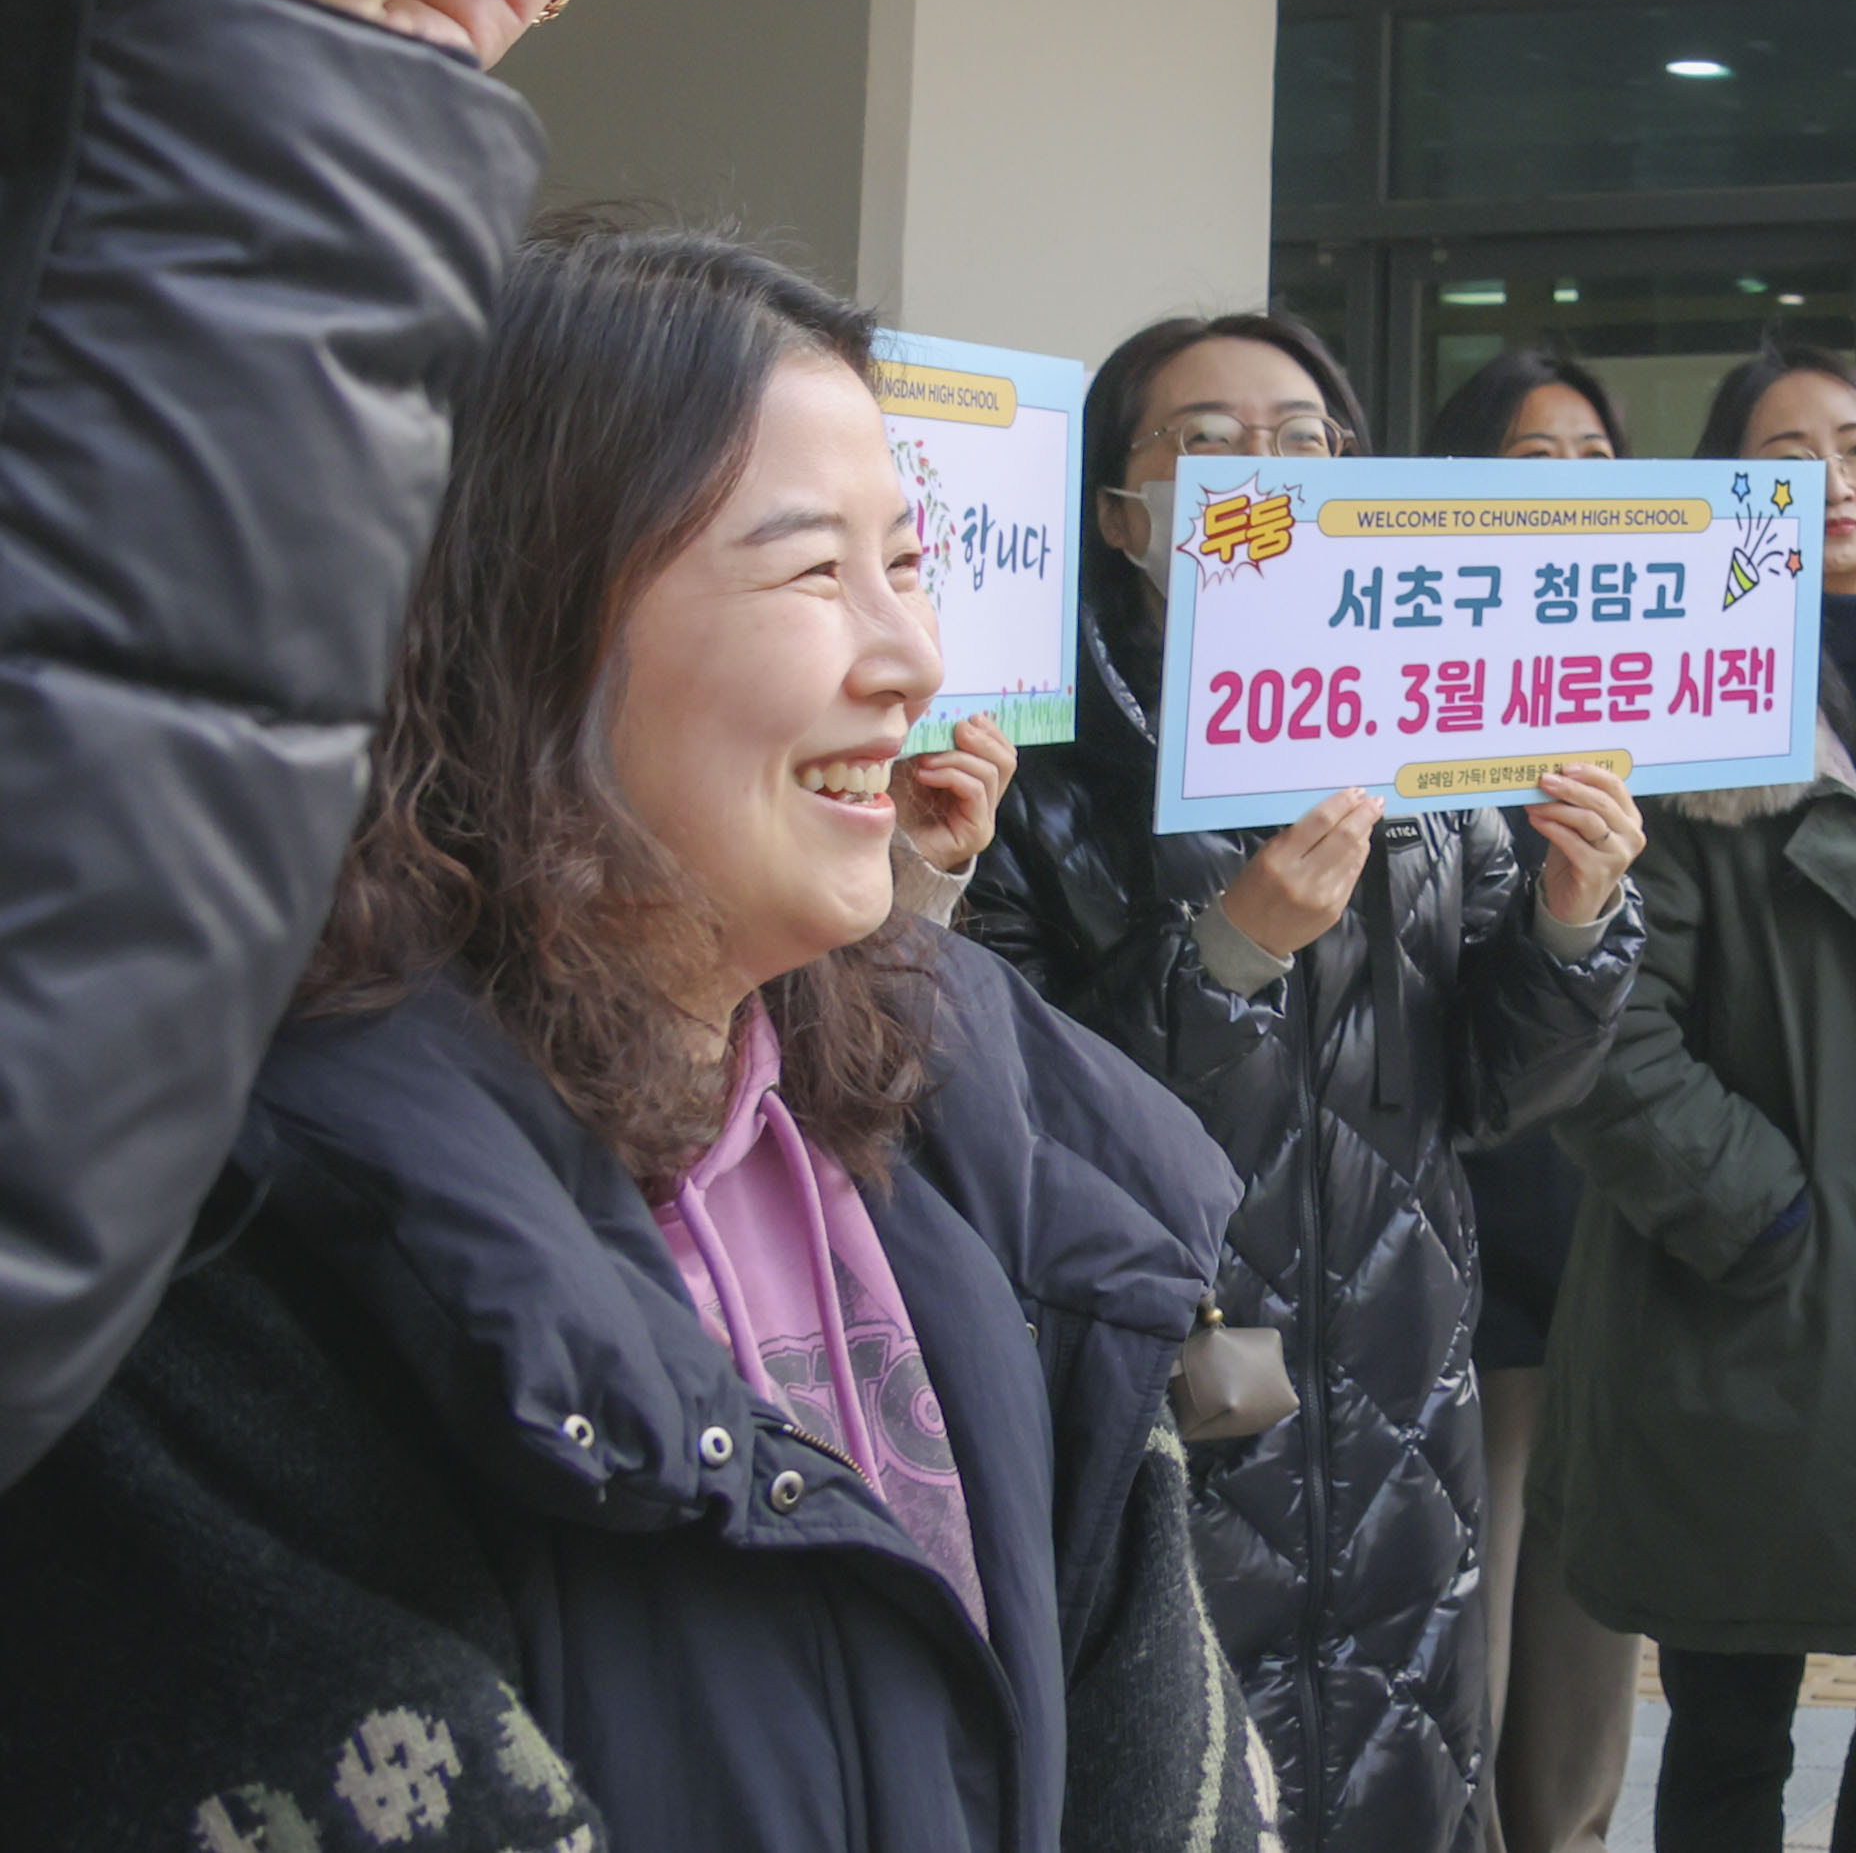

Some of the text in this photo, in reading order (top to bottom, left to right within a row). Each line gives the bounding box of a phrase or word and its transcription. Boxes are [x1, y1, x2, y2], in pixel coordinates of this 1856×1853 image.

[871, 375, 999, 411] UNGDAM HIGH SCHOOL
[961, 503, 1051, 591] 합니다
[1199, 494, 1296, 564] 두둥
[1356, 509, 1689, 528] WELCOME TO CHUNGDAM HIGH SCHOOL
[1327, 561, 1687, 630] 서초구 청담고
[1205, 646, 1776, 745] 2026. 3월 새로운 시작!
[1416, 770, 1454, 790] 설레임
[1457, 767, 1486, 786] 가득!
